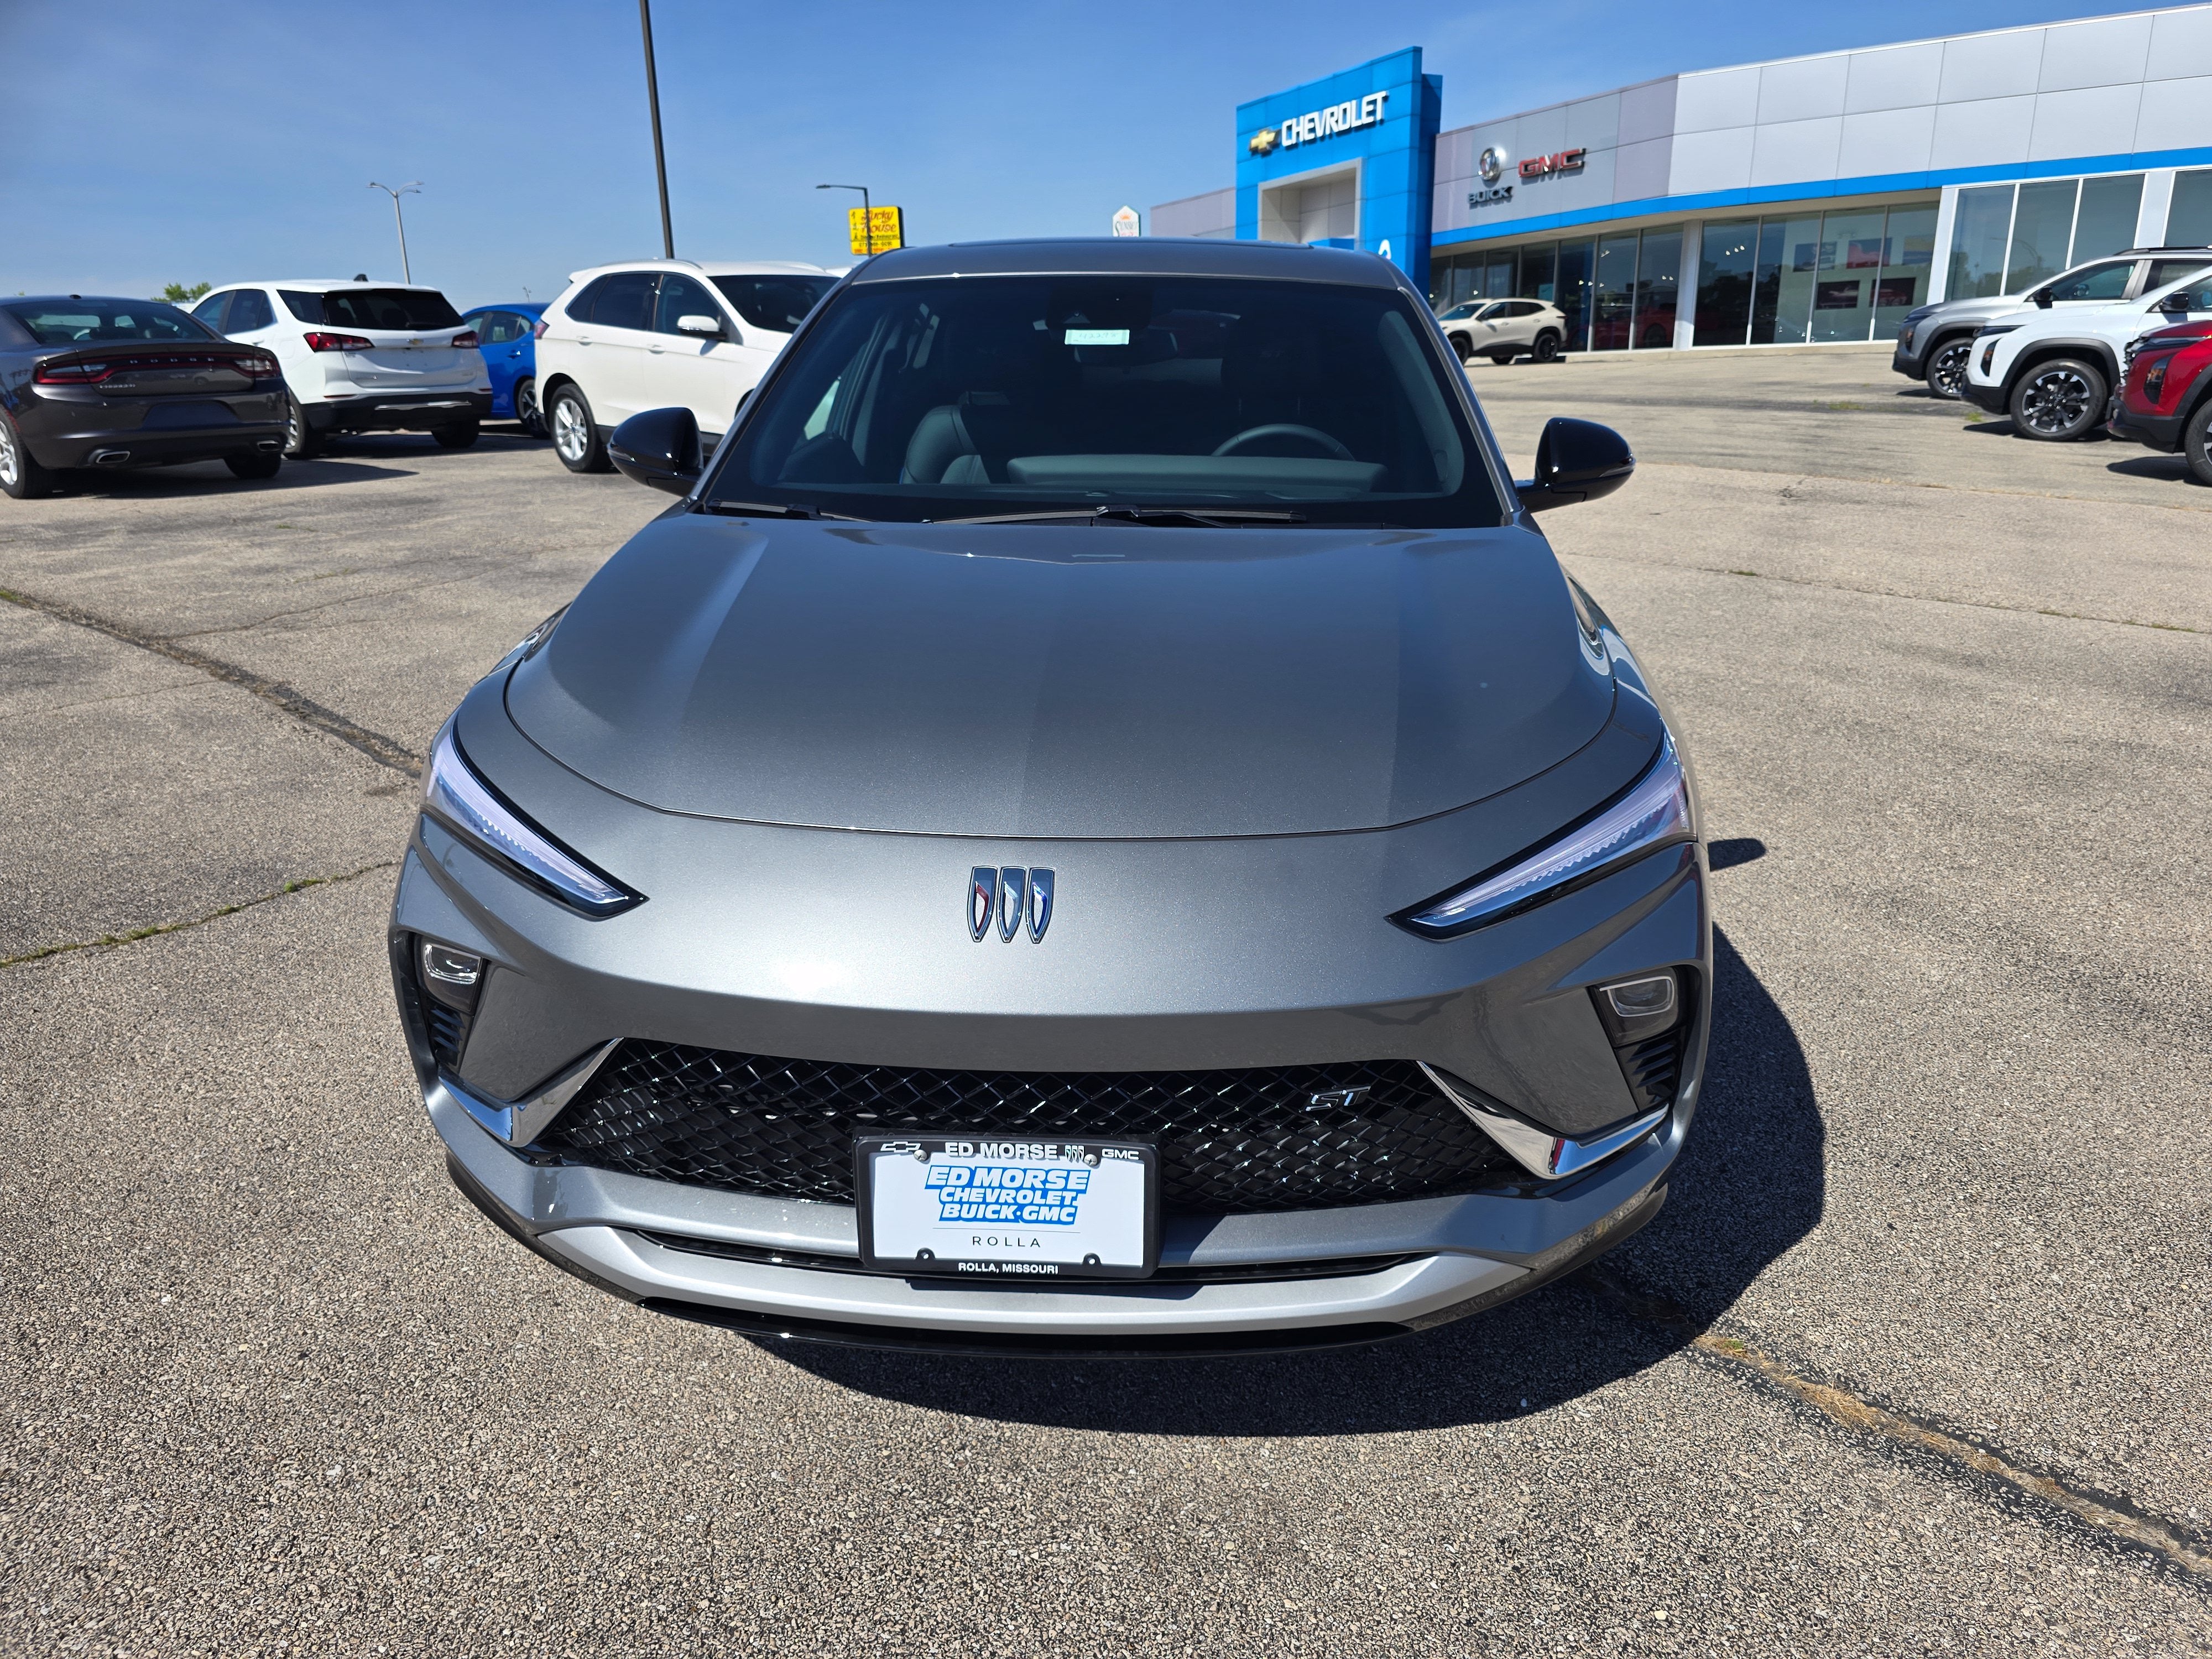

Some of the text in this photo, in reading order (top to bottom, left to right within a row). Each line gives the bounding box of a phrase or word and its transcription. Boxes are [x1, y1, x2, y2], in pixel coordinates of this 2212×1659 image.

[1281, 90, 1388, 148] CHEVROLET
[1518, 148, 1585, 178] GMC
[1468, 186, 1513, 204] BUICK
[945, 1142, 1057, 1160] ED MORSE
[1102, 1149, 1139, 1160] GMC
[927, 1166, 1088, 1190] ED MORSE
[940, 1187, 1077, 1206] CHEVROLET
[972, 1236, 1041, 1248] ROLLA
[958, 1262, 1058, 1275] ROLLA, MISSOURI
